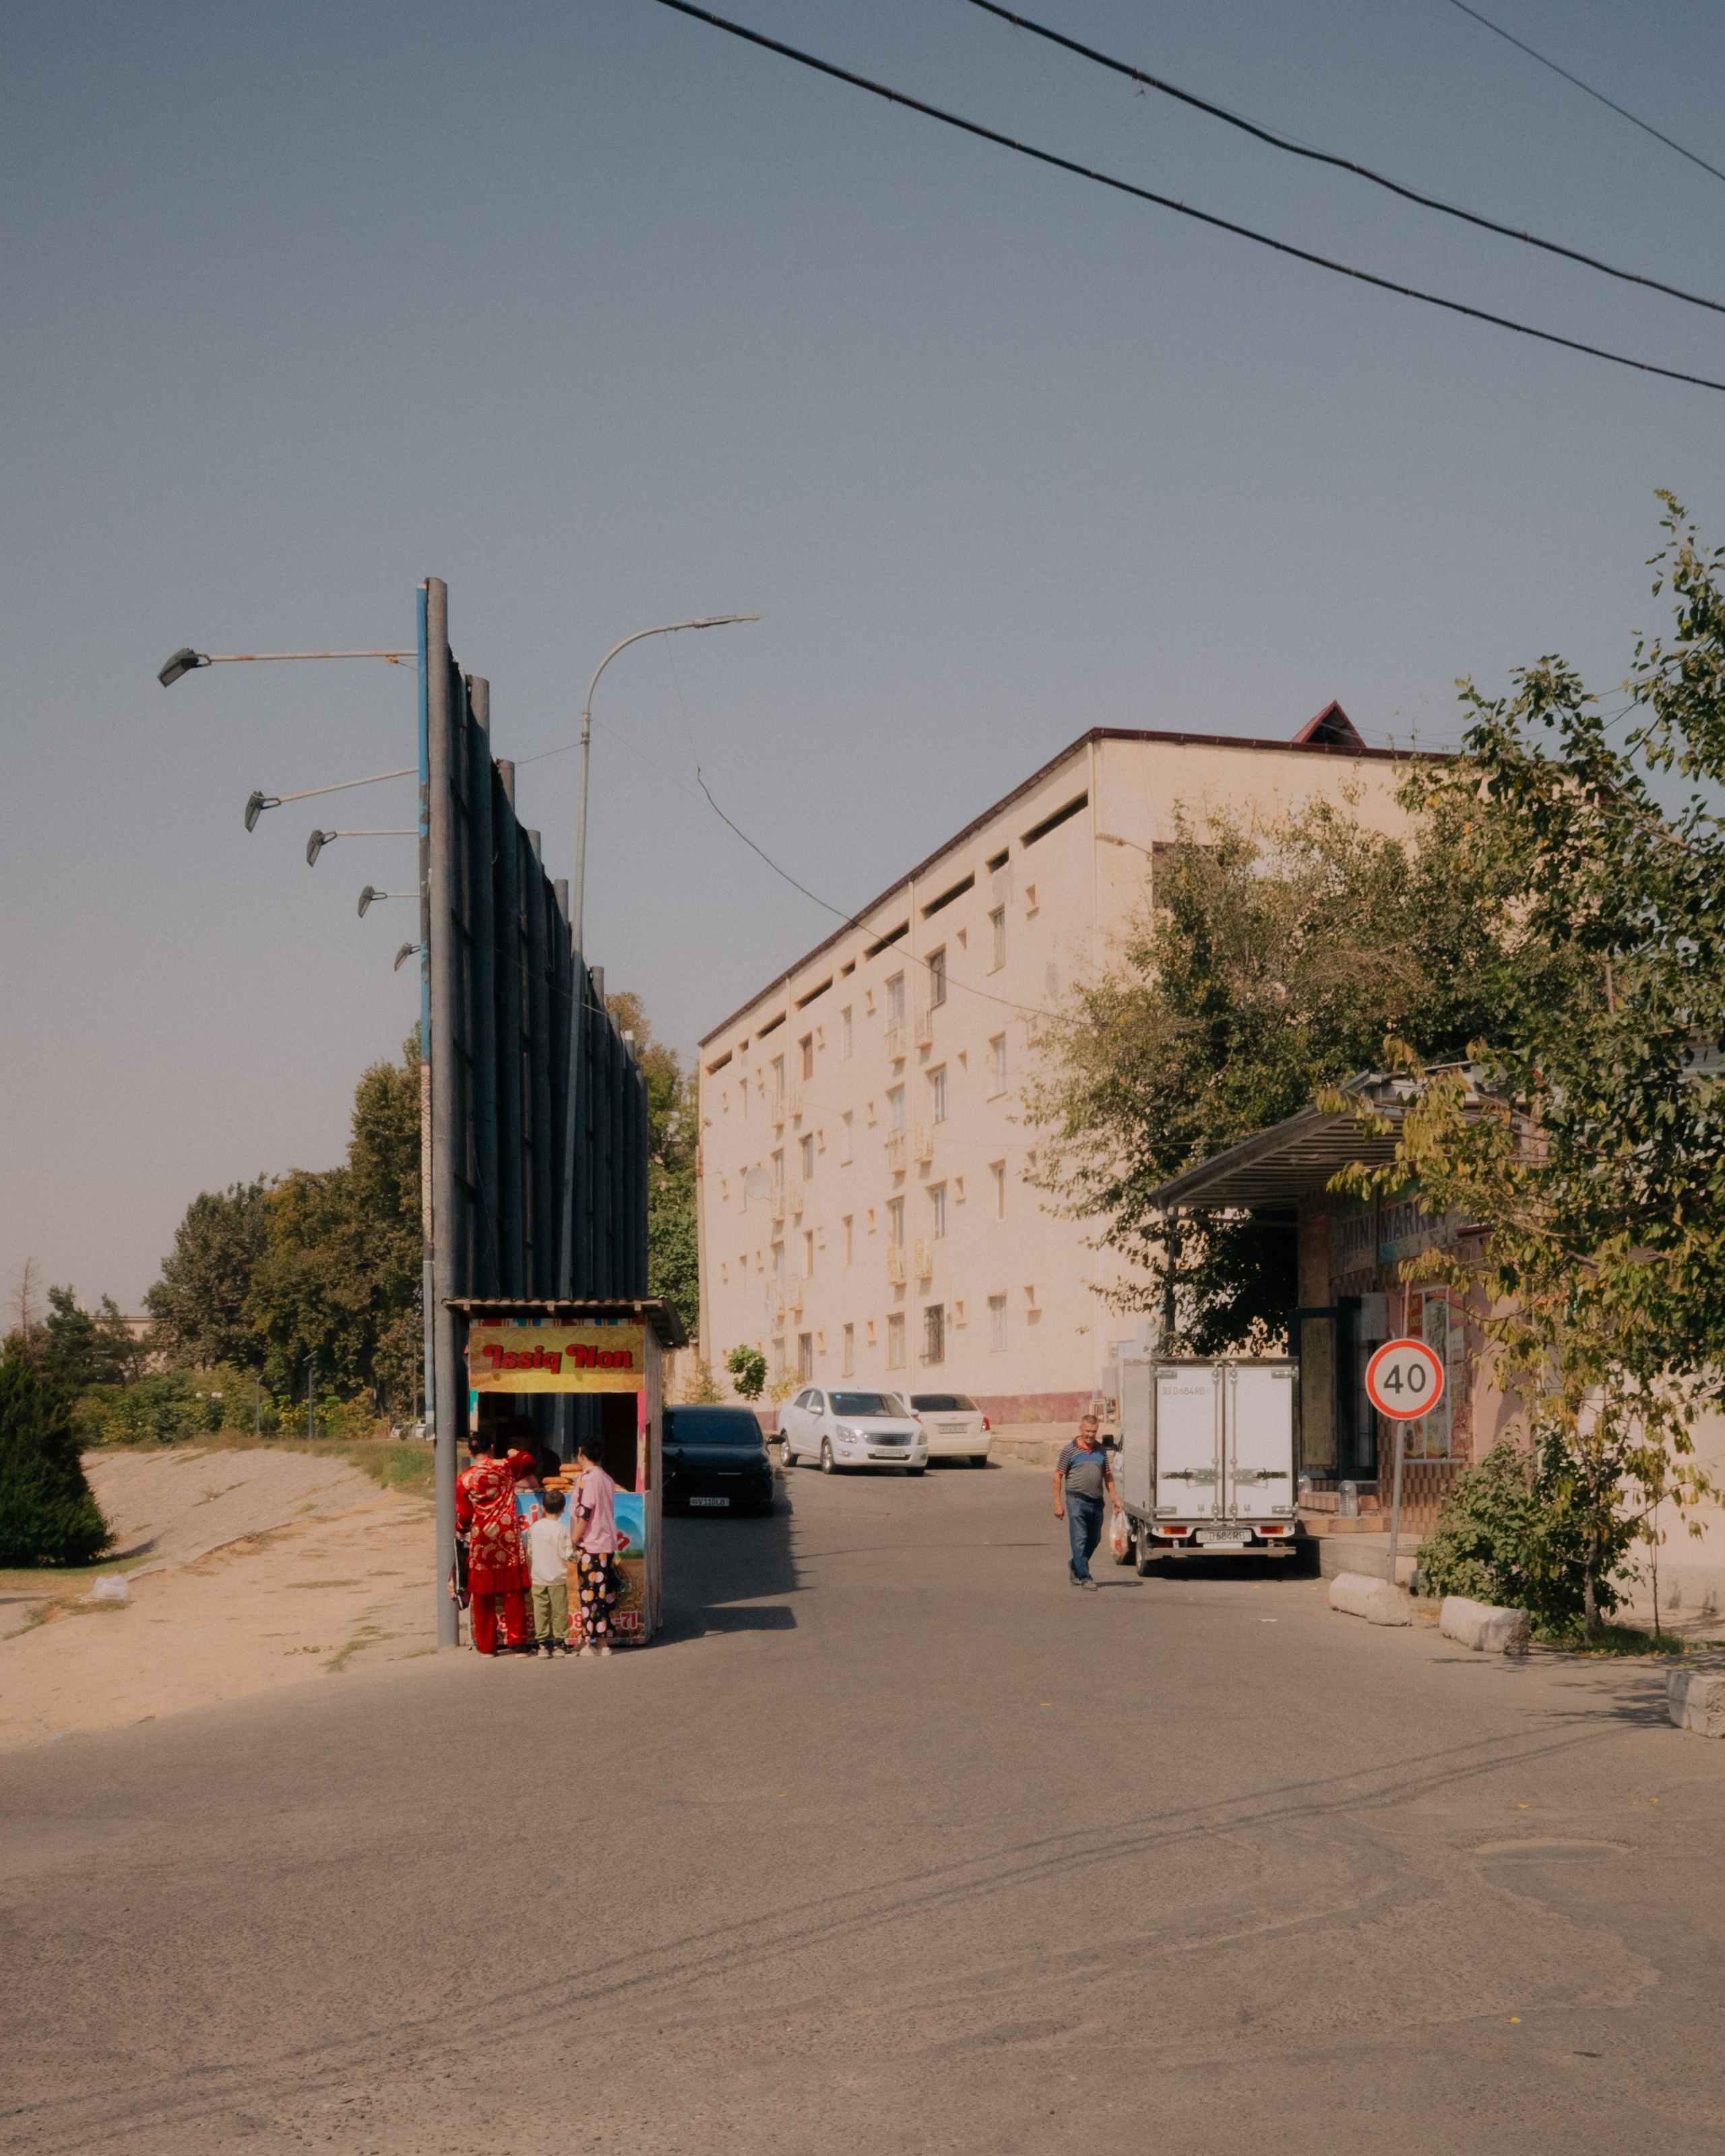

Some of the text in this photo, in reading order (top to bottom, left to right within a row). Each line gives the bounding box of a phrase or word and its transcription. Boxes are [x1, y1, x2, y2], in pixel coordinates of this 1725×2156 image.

[482, 1343, 633, 1374] Issiq Non
[1383, 1364, 1426, 1395] 40
